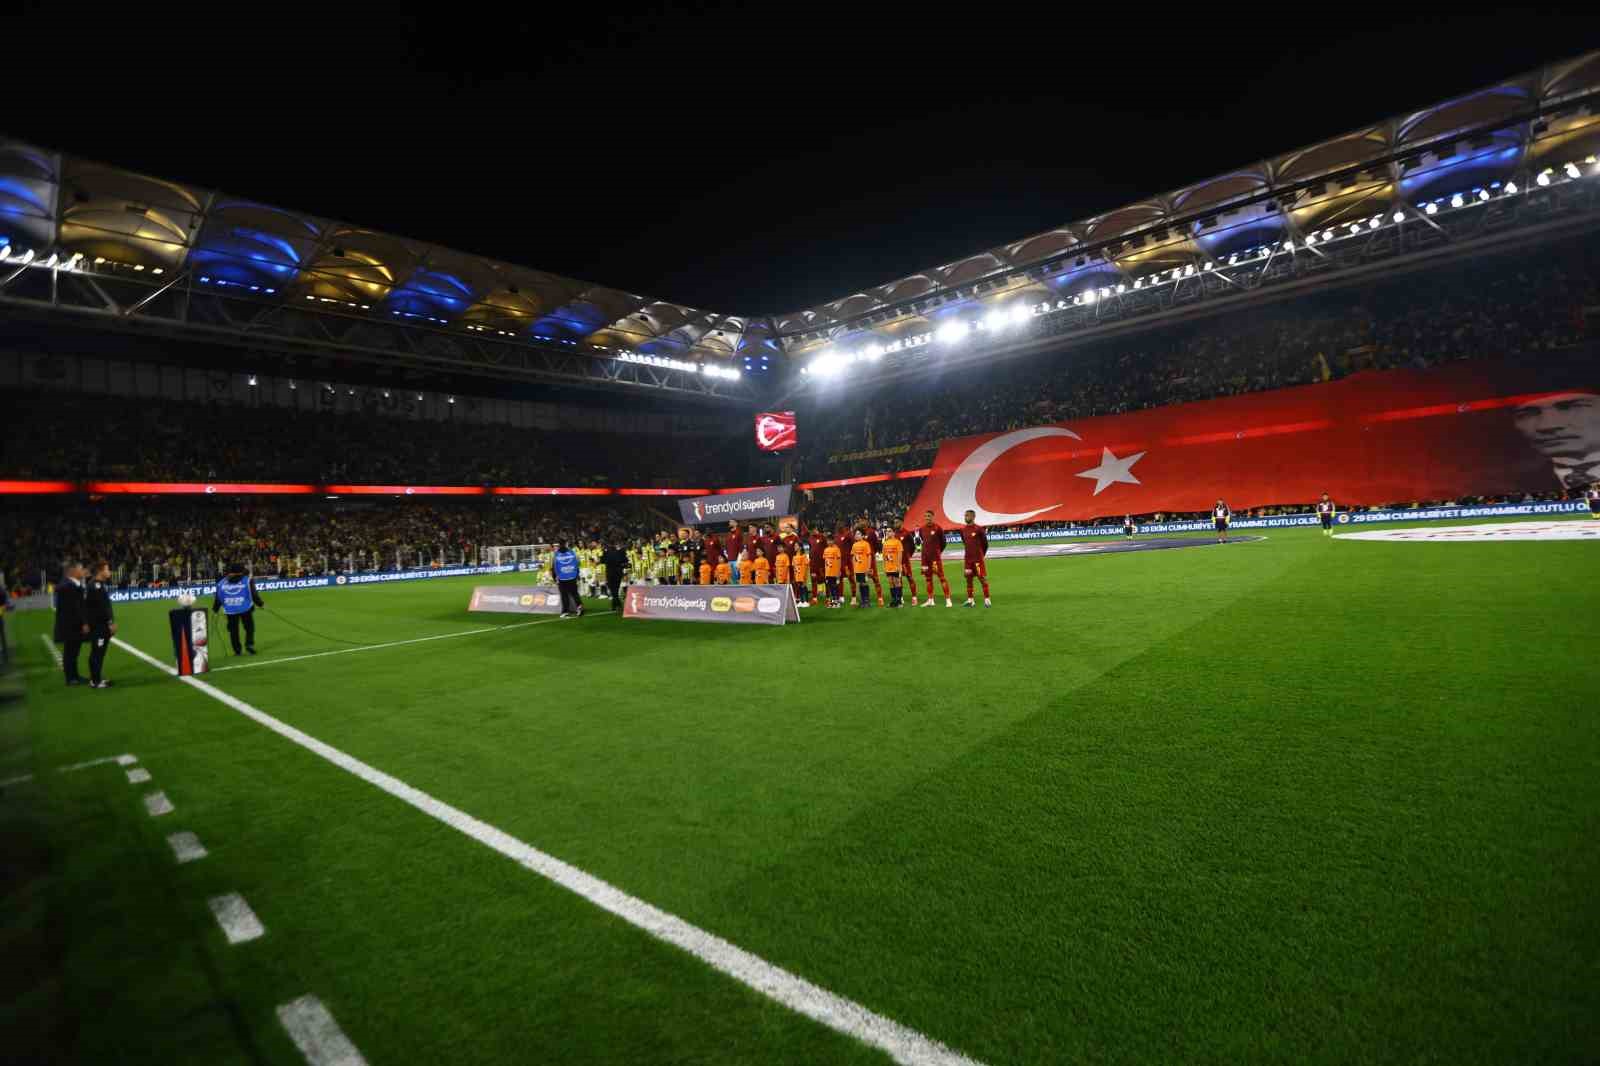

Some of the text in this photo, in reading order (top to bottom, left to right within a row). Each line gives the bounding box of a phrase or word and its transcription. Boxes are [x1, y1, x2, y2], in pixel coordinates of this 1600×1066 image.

[705, 498, 742, 514] trendyol
[1534, 502, 1575, 513] KUTLU
[1268, 518, 1297, 527] KUTLU
[1297, 516, 1321, 525] OLSU
[131, 586, 203, 600] CUMHURİYET
[265, 580, 297, 590] KUTLU
[643, 595, 677, 610] trendyol
